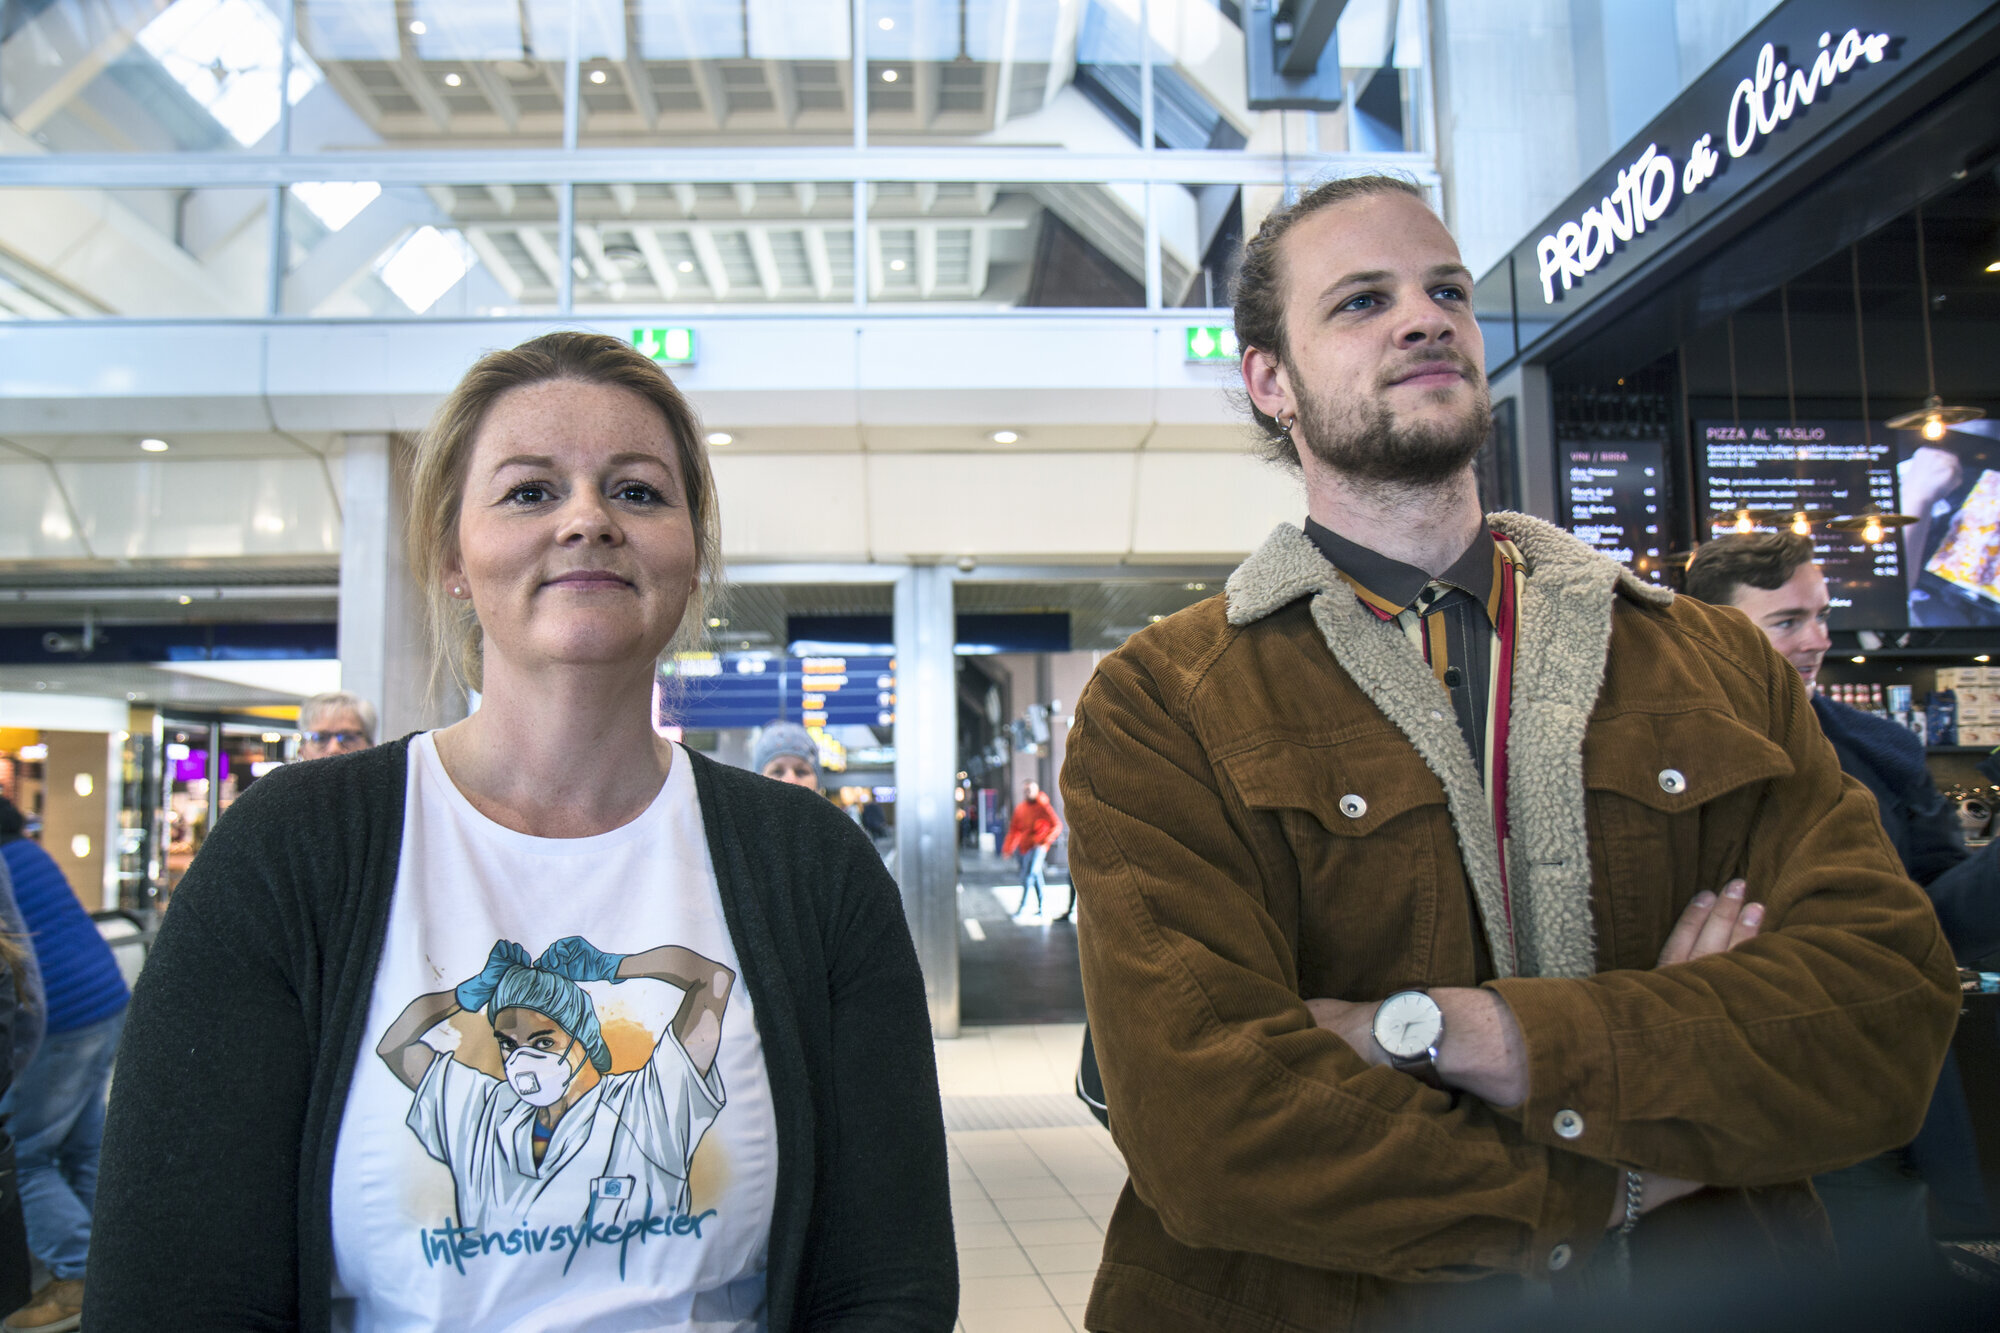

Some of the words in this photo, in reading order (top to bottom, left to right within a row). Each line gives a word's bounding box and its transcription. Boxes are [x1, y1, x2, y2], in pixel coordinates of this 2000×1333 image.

[1537, 143, 1674, 304] PRONTO
[1683, 134, 1718, 194] di
[1727, 28, 1889, 158] Olivia
[1706, 427, 1747, 440] PIZZA
[1751, 427, 1771, 440] AL
[1775, 427, 1825, 440] TAGLIO
[420, 1189, 717, 1281] Intensivsykepleier
